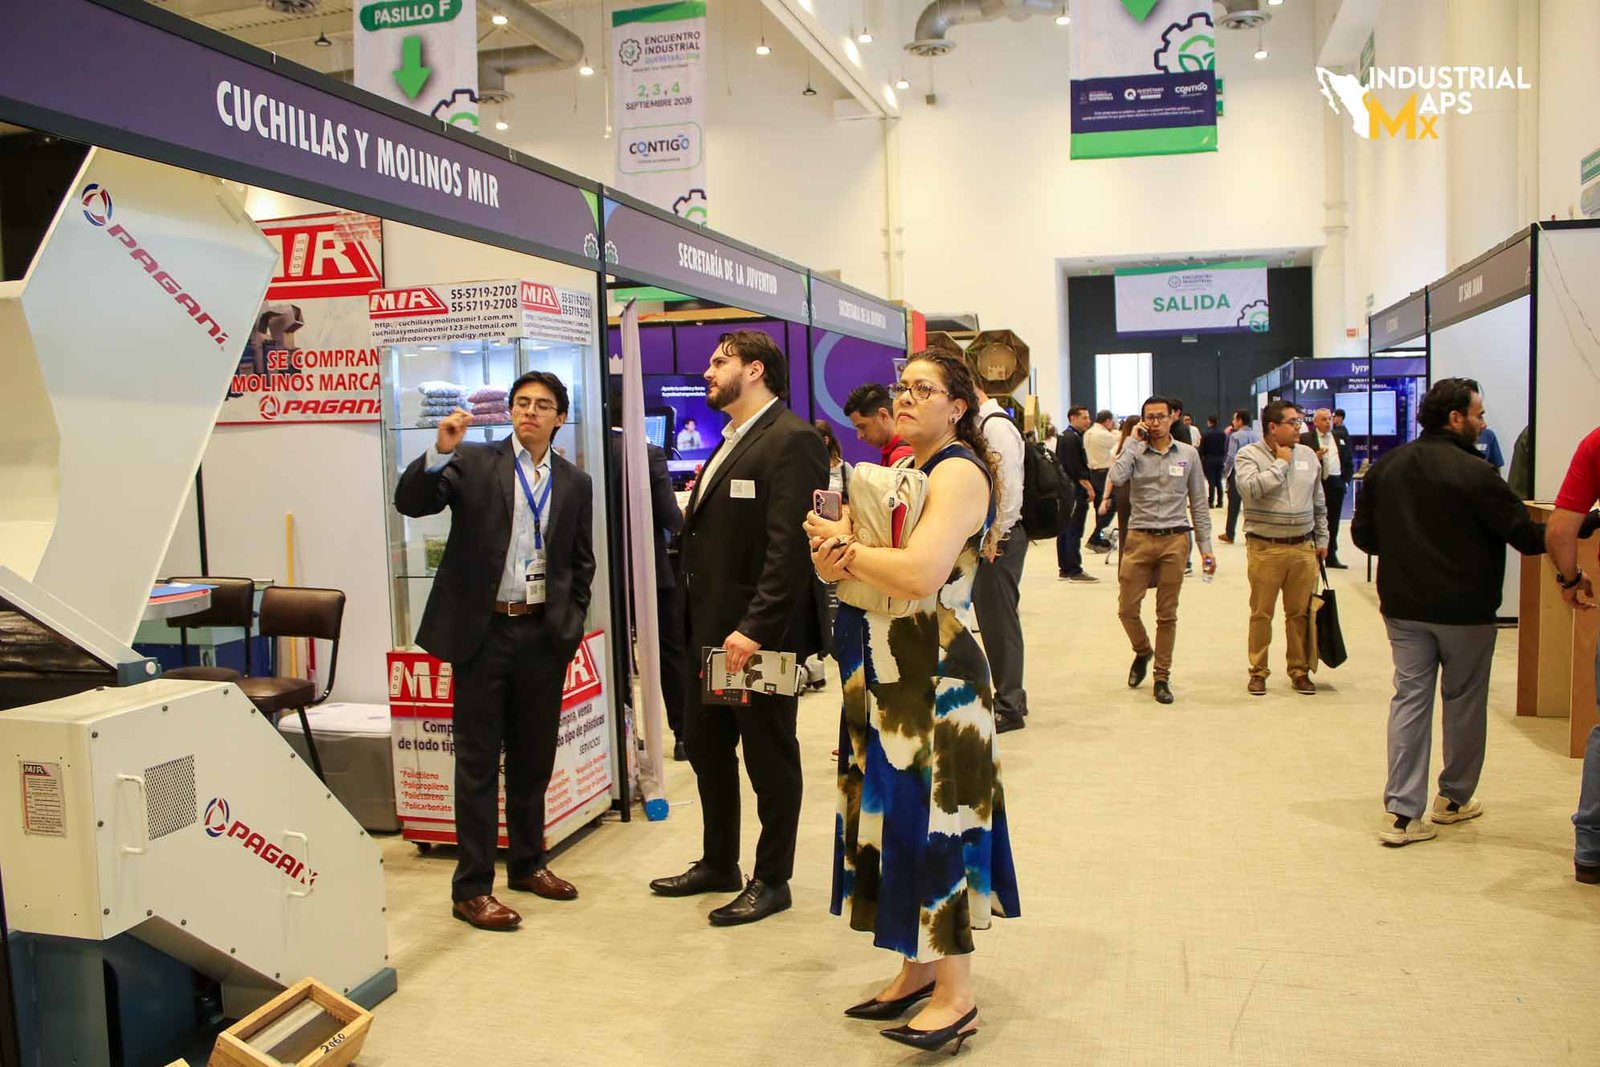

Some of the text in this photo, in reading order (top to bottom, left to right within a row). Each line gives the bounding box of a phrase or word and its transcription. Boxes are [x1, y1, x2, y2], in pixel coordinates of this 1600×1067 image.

[374, 0, 451, 25] PASILLO F
[644, 31, 700, 45] ENCUENTRO
[644, 42, 700, 55] INDUSTRIAL
[671, 81, 680, 93] 4
[625, 98, 672, 111] SEPTIEMBRE
[216, 80, 500, 208] CUCHILLAS Y MOLINOS MIR
[629, 137, 689, 155] CONTIGO
[267, 231, 358, 278] IR
[677, 241, 778, 295] SECRETARÍA DE LA JUVENTUD
[370, 290, 434, 312] MIR
[451, 285, 517, 300] 55-5719-2707
[522, 284, 556, 306] MIR
[451, 298, 518, 313] 55-5719-2708
[1153, 293, 1231, 312] SALIDA
[268, 349, 380, 370] SE COMPRAN
[231, 373, 315, 393] MOLINOS
[389, 661, 454, 699] MI
[422, 720, 455, 736] Comp
[398, 738, 456, 755] de todo tip
[25, 765, 44, 774] MIR
